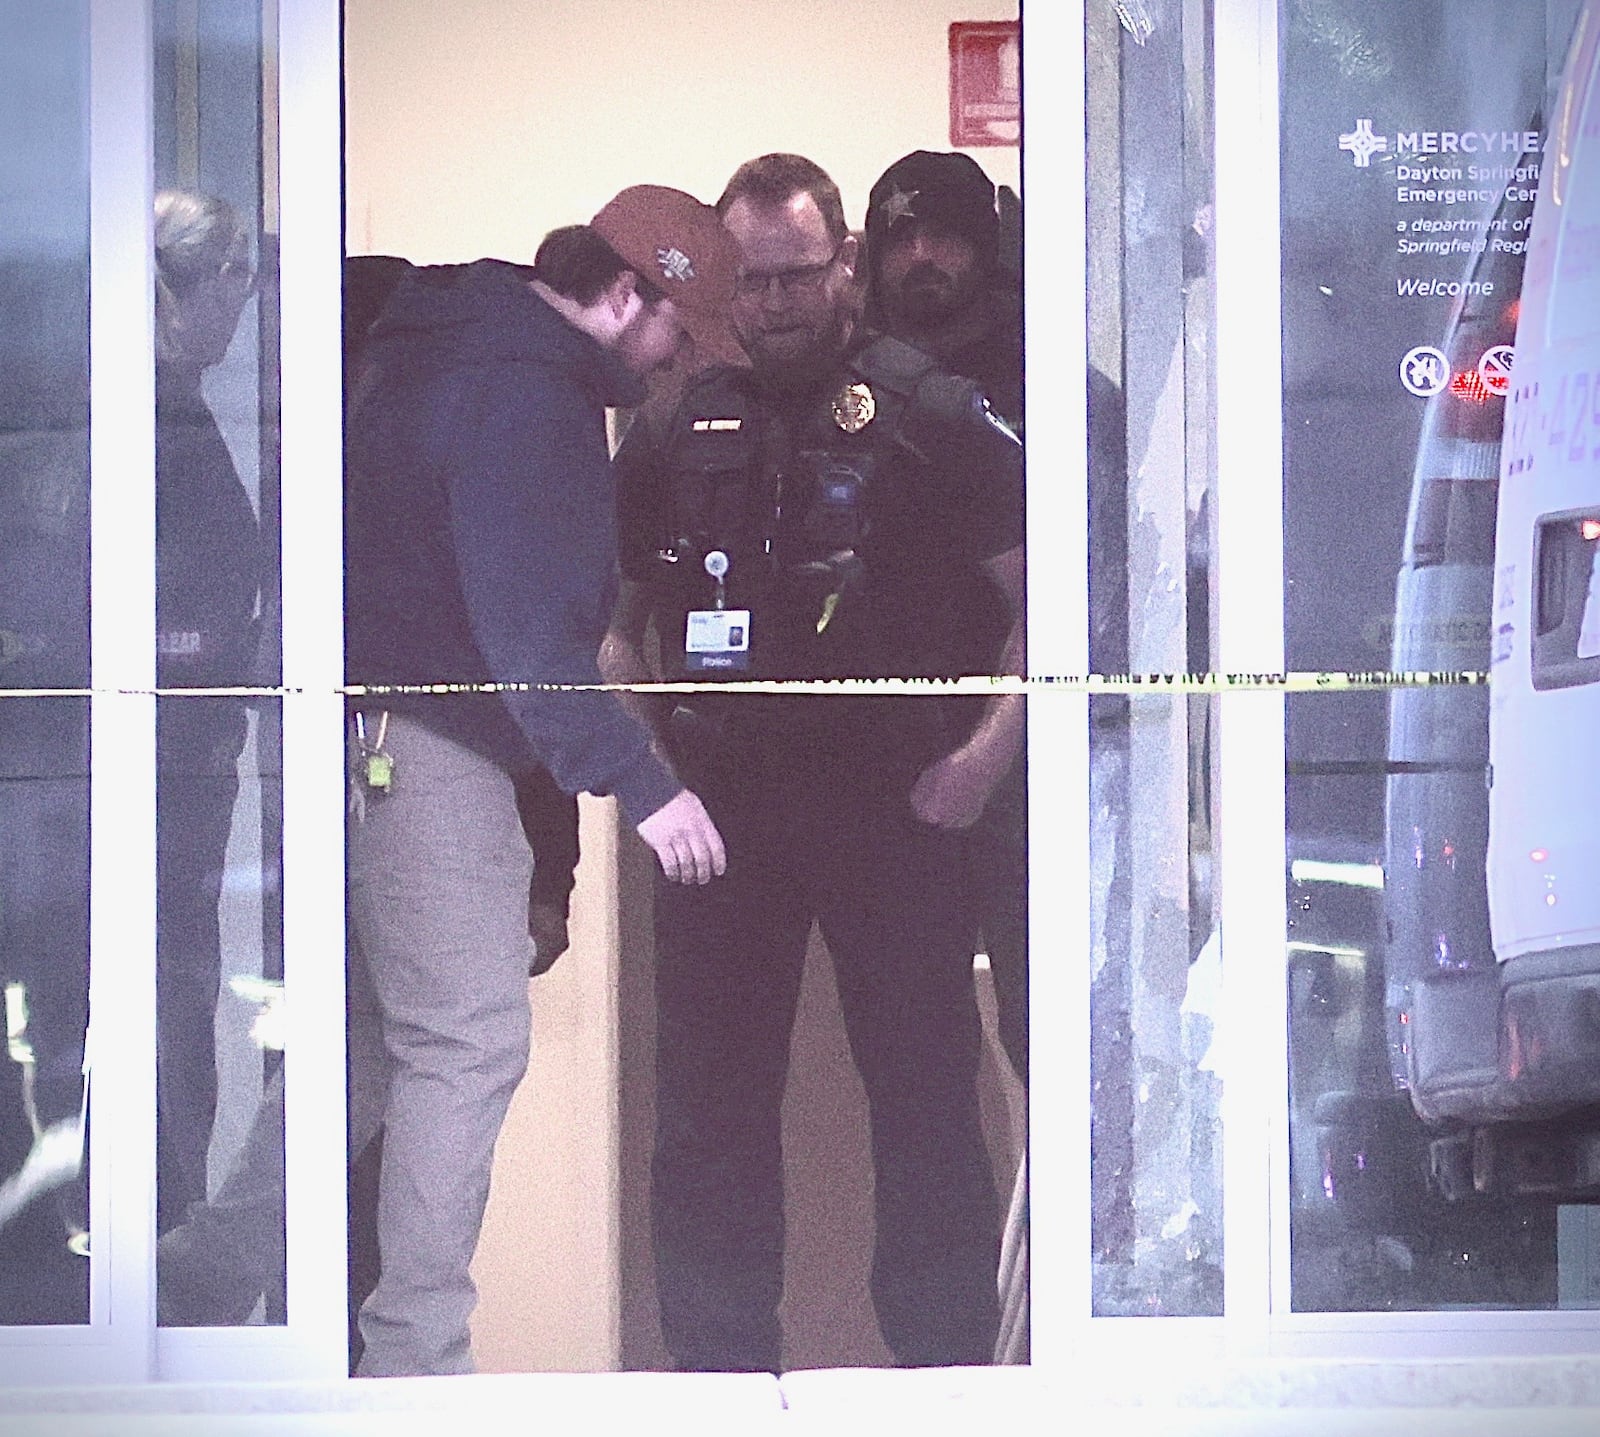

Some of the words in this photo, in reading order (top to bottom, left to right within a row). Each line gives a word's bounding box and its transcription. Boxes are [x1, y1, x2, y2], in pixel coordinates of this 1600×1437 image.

[1397, 131, 1545, 153] MERCYHE
[1396, 165, 1462, 183] Dayton
[1396, 187, 1500, 204] Emergency
[1396, 221, 1406, 232] a
[1411, 218, 1507, 234] department
[1512, 217, 1531, 232] of
[1396, 238, 1488, 255] Springfield
[1396, 279, 1494, 296] Welcome
